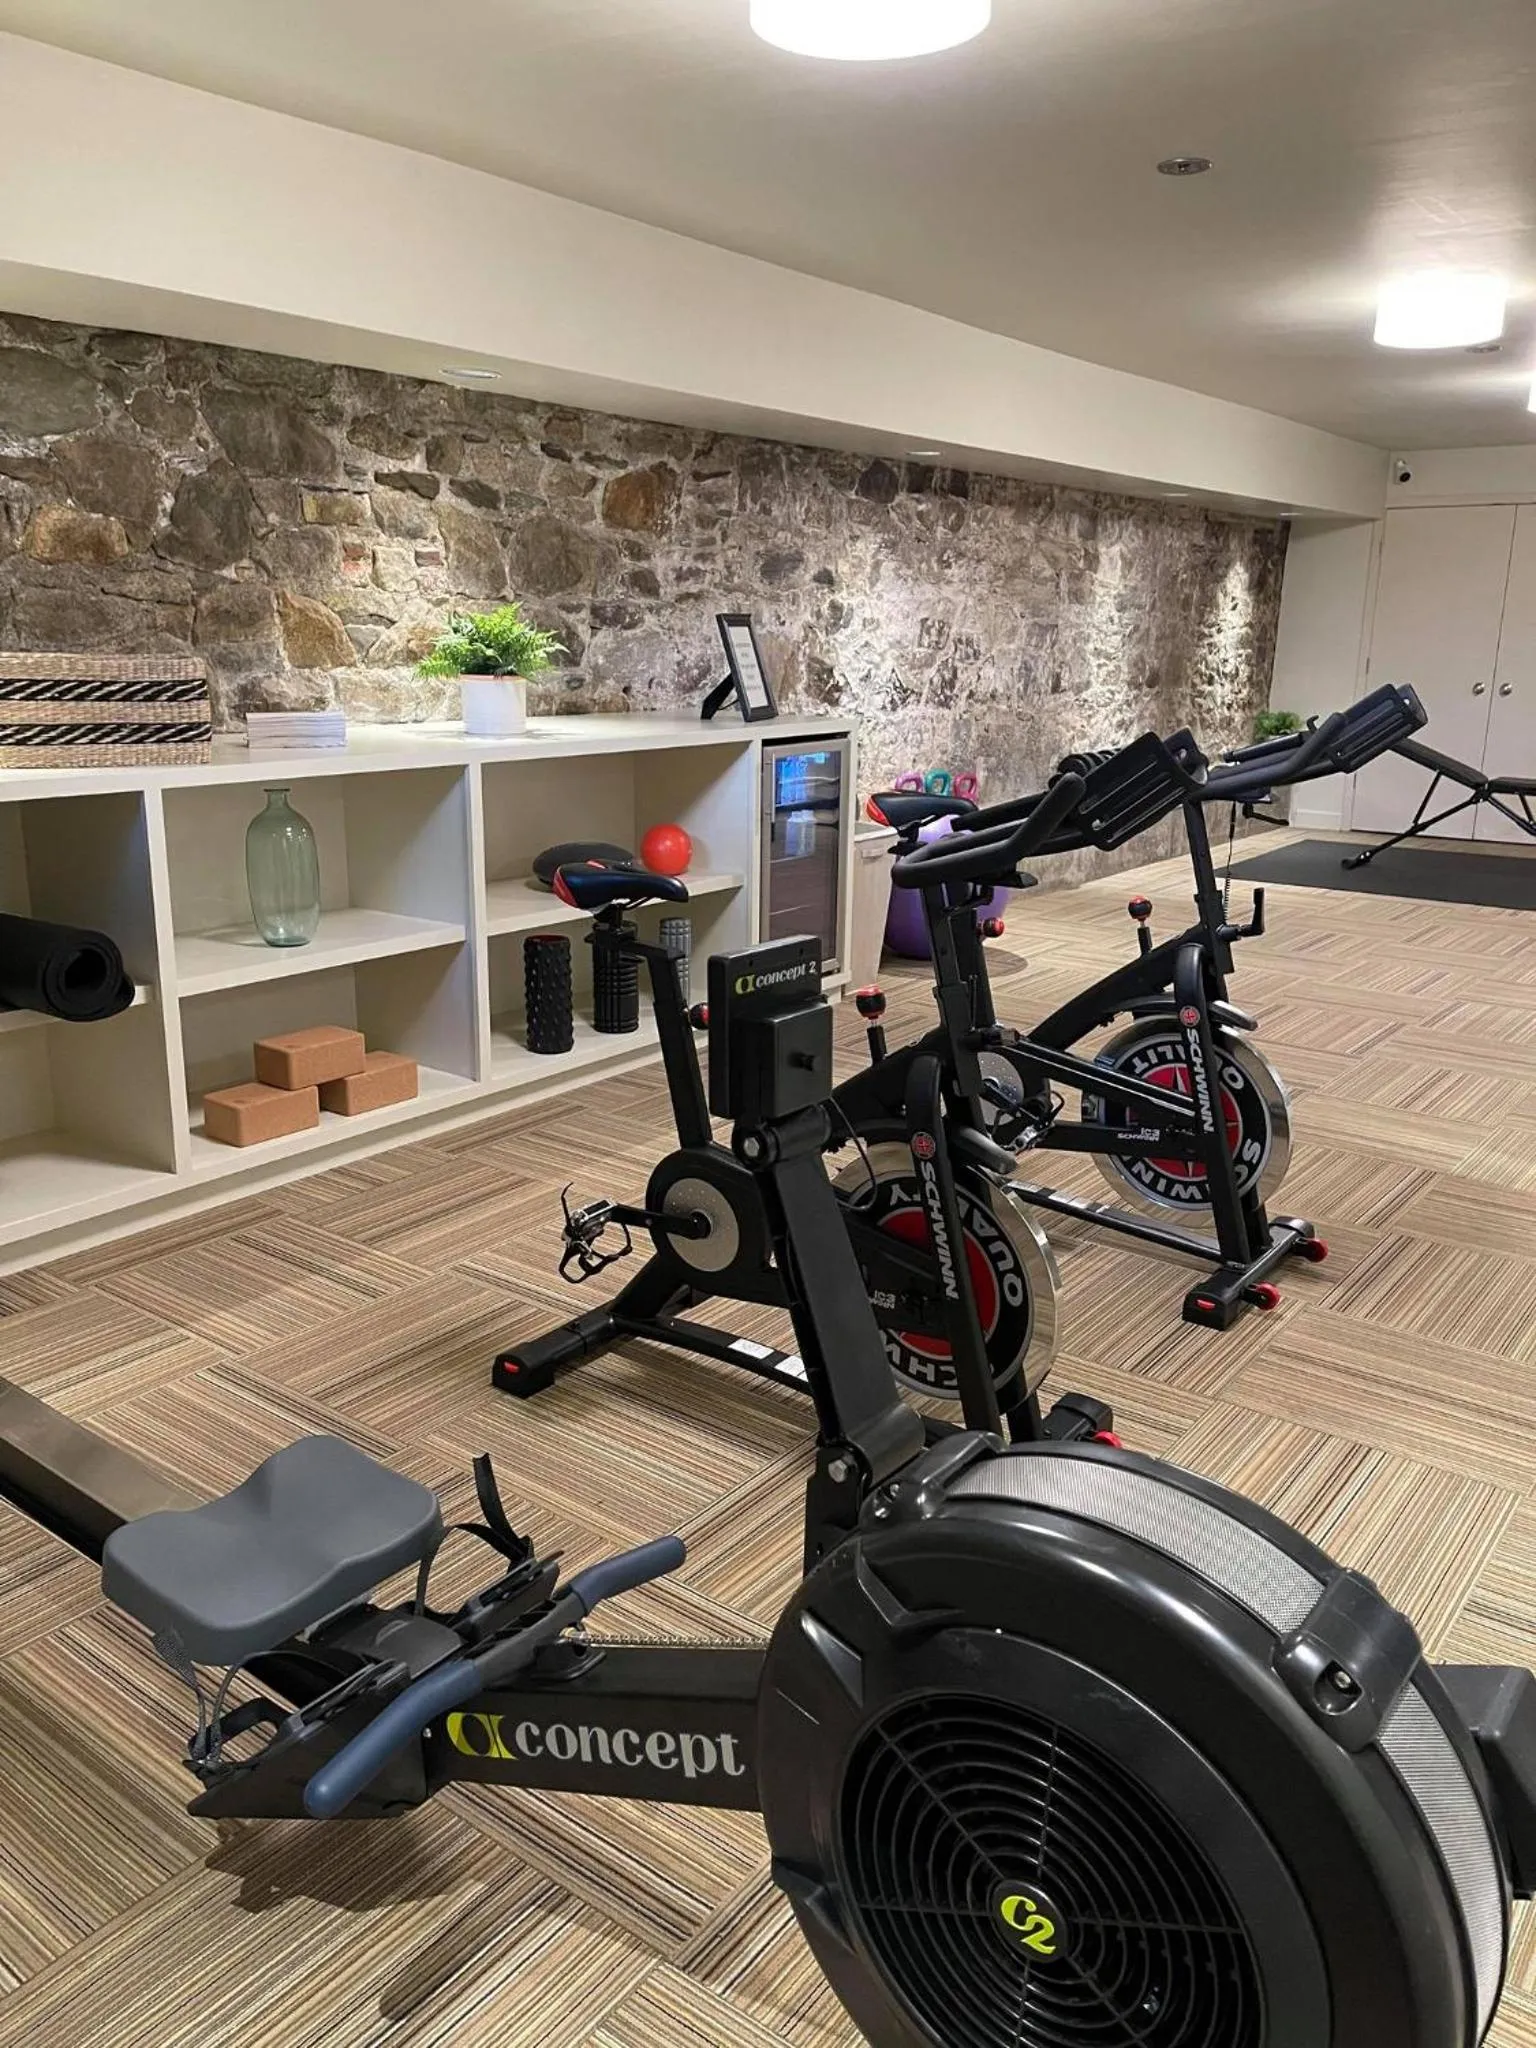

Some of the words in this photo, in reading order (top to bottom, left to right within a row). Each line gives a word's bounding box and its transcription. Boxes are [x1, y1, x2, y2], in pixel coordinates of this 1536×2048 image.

[755, 963, 806, 988] concept
[809, 960, 817, 974] 2
[1185, 1028, 1215, 1133] SCHWINN
[920, 1160, 960, 1300] SCHWINN
[514, 1720, 746, 1779] concept
[1001, 1895, 1057, 1955] C2
